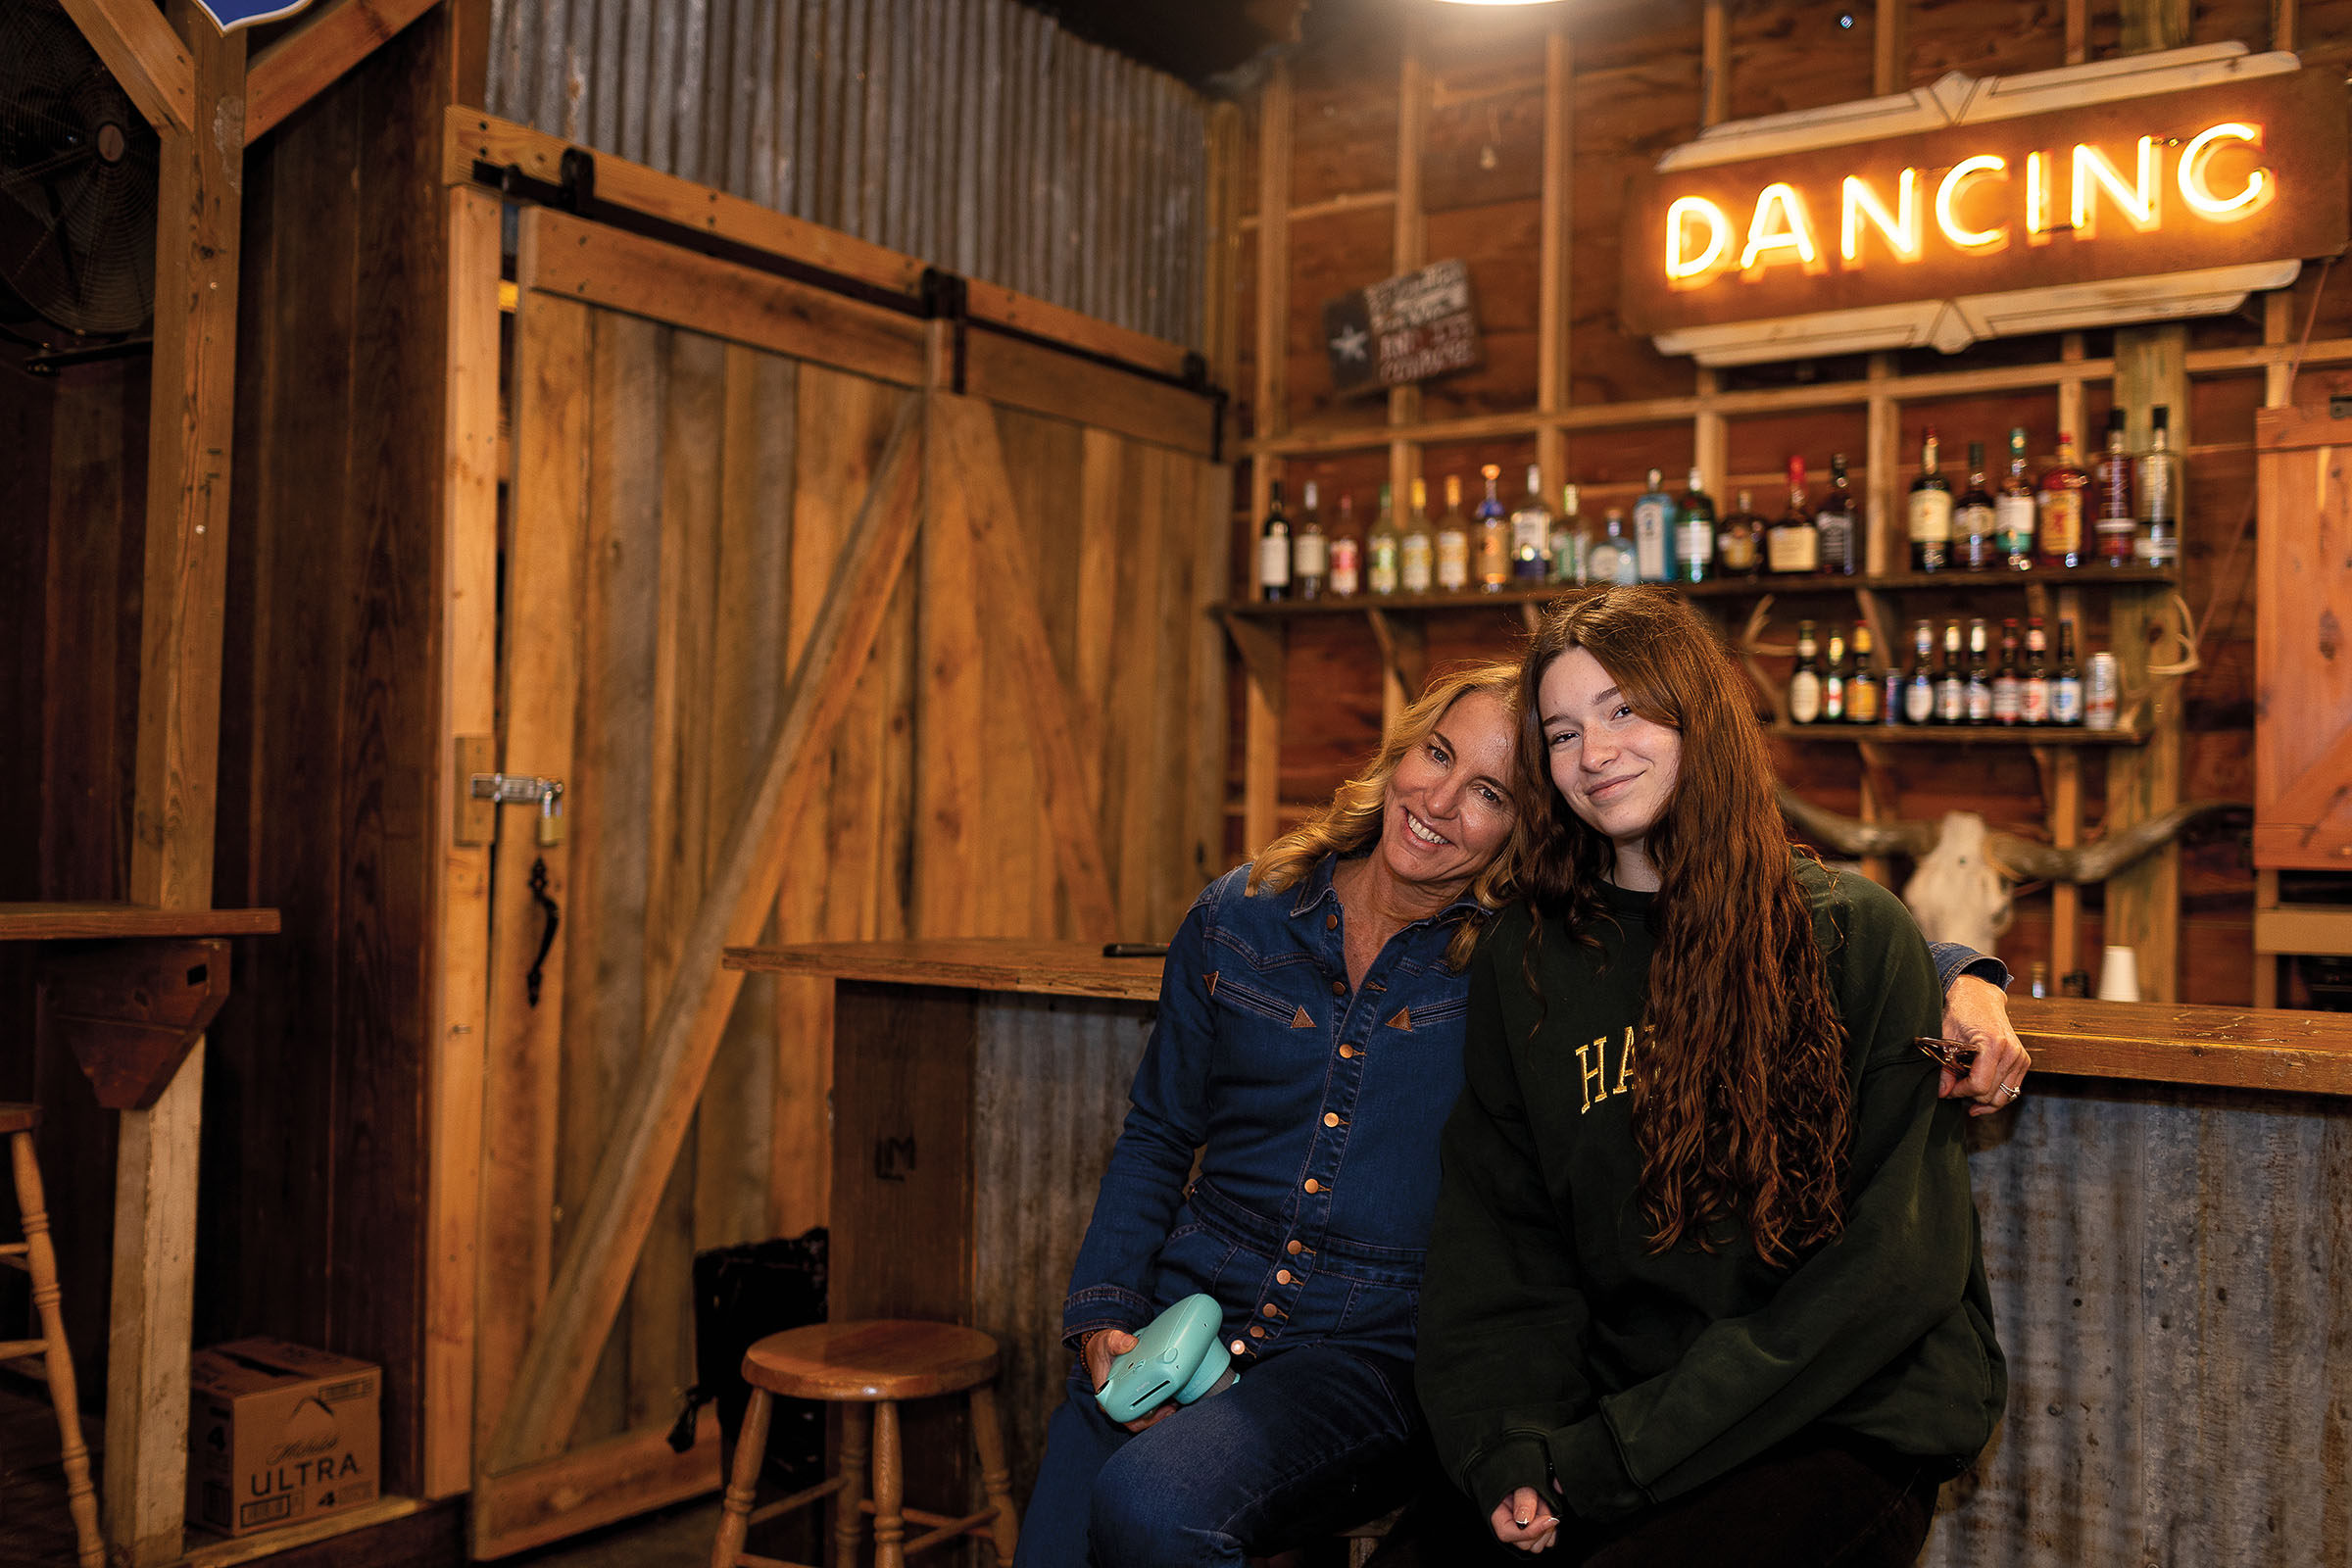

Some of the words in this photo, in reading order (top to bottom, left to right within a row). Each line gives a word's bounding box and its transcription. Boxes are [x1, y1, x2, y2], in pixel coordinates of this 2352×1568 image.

[1663, 122, 2276, 286] DANCING
[1575, 1025, 1656, 1115] HA
[251, 1452, 359, 1496] ULTRA
